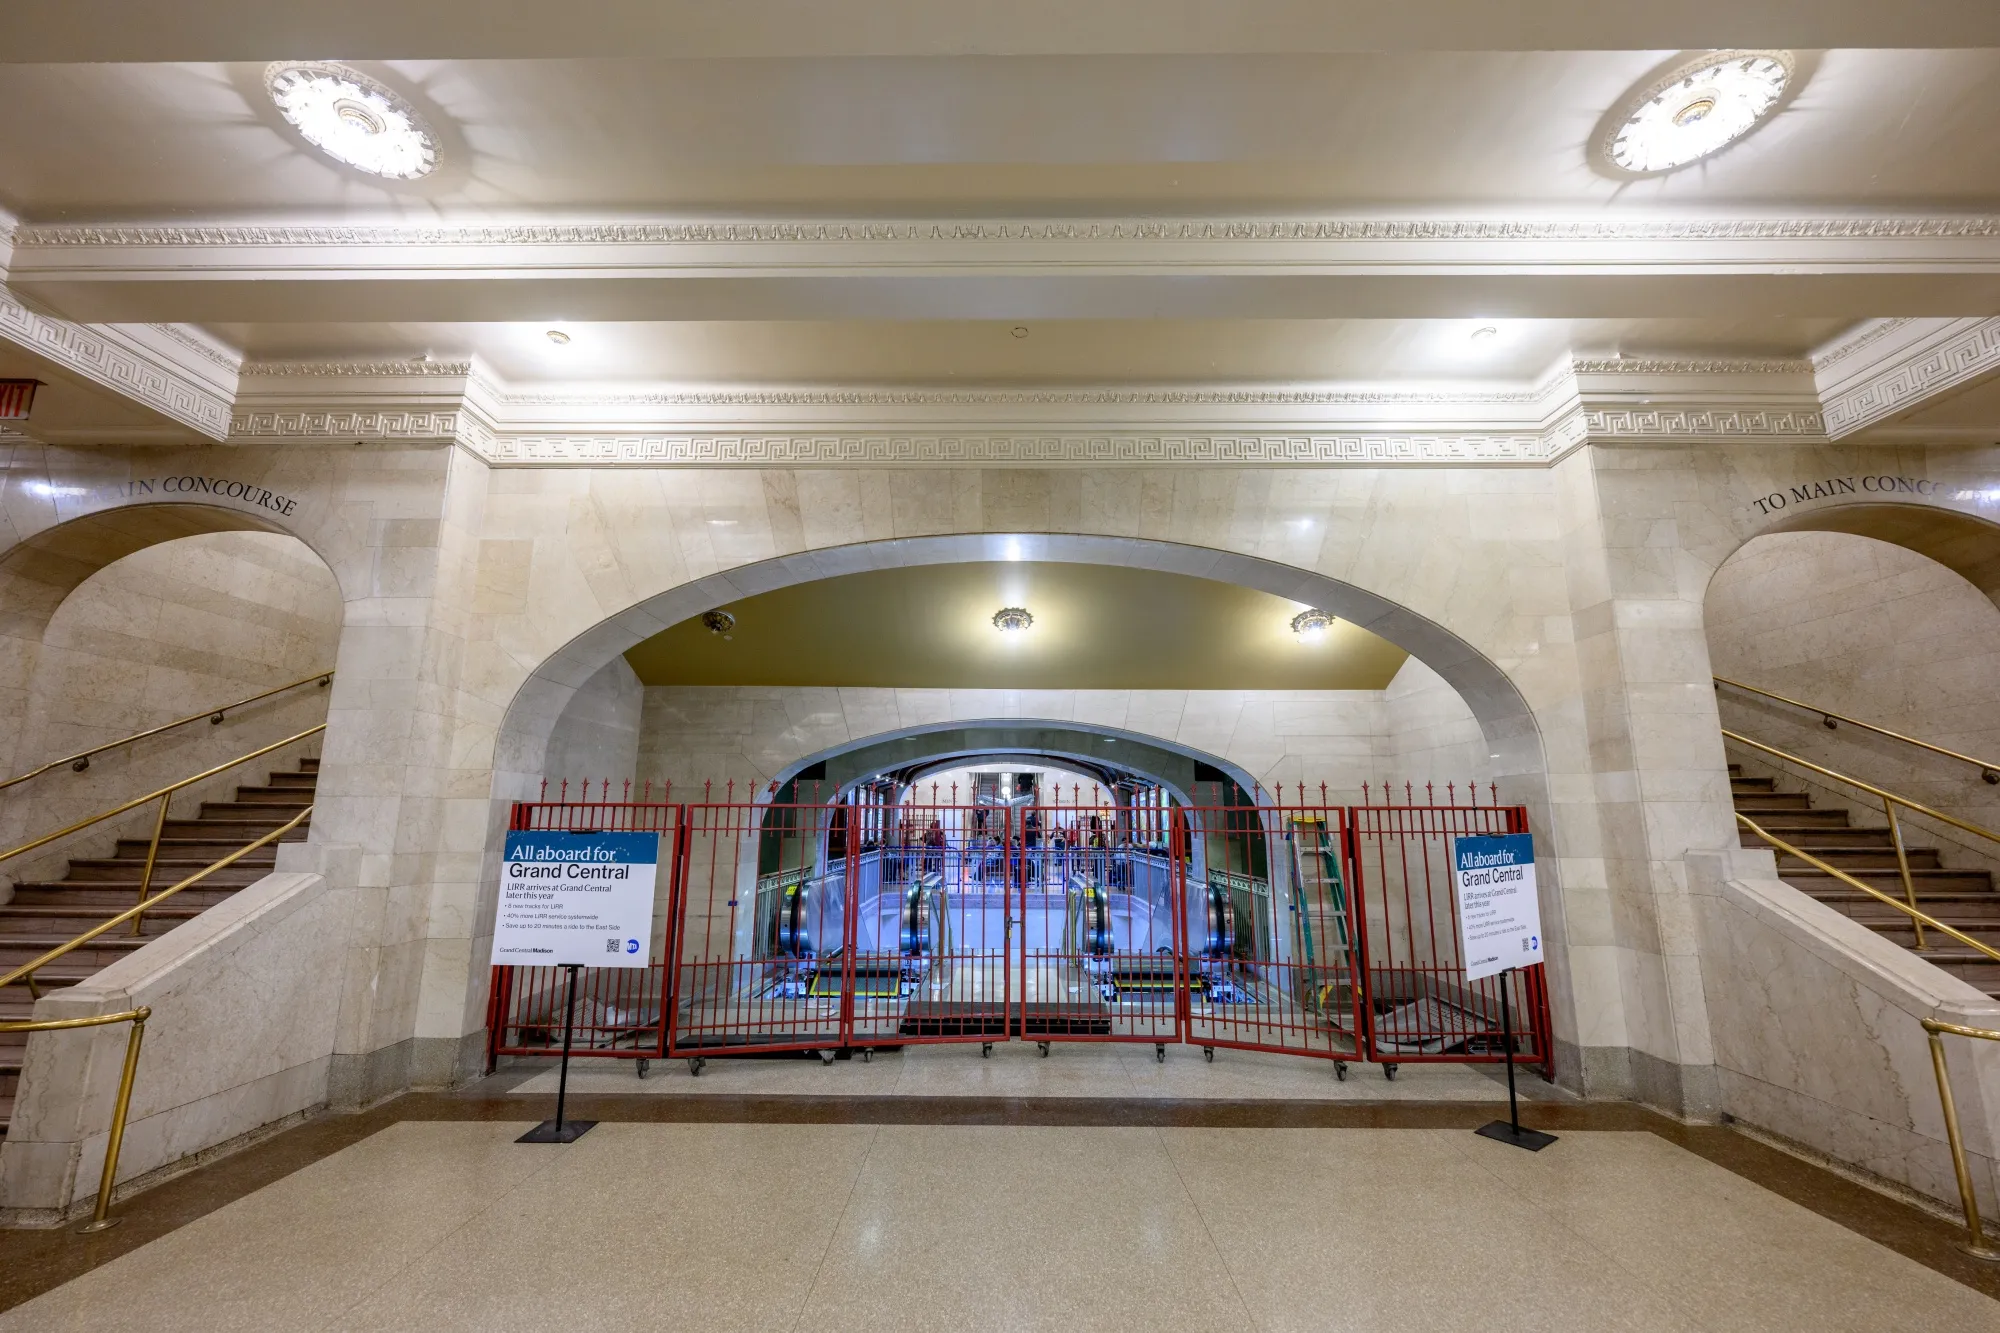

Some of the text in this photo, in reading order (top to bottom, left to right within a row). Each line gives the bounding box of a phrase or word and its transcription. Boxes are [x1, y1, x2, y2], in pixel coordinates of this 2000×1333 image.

[162, 476, 297, 517] CONCOURSE
[1753, 493, 1786, 515] TO
[1789, 477, 1857, 504] MAIN
[510, 845, 616, 861] All aboard for
[1461, 849, 1514, 868] All aboard for
[509, 863, 629, 880] Grand Central
[1462, 866, 1523, 887] Grand Central
[506, 891, 523, 899] later
[538, 892, 554, 900] year
[507, 883, 526, 891] LIRR
[560, 884, 583, 892] Grand
[584, 884, 612, 892] Central
